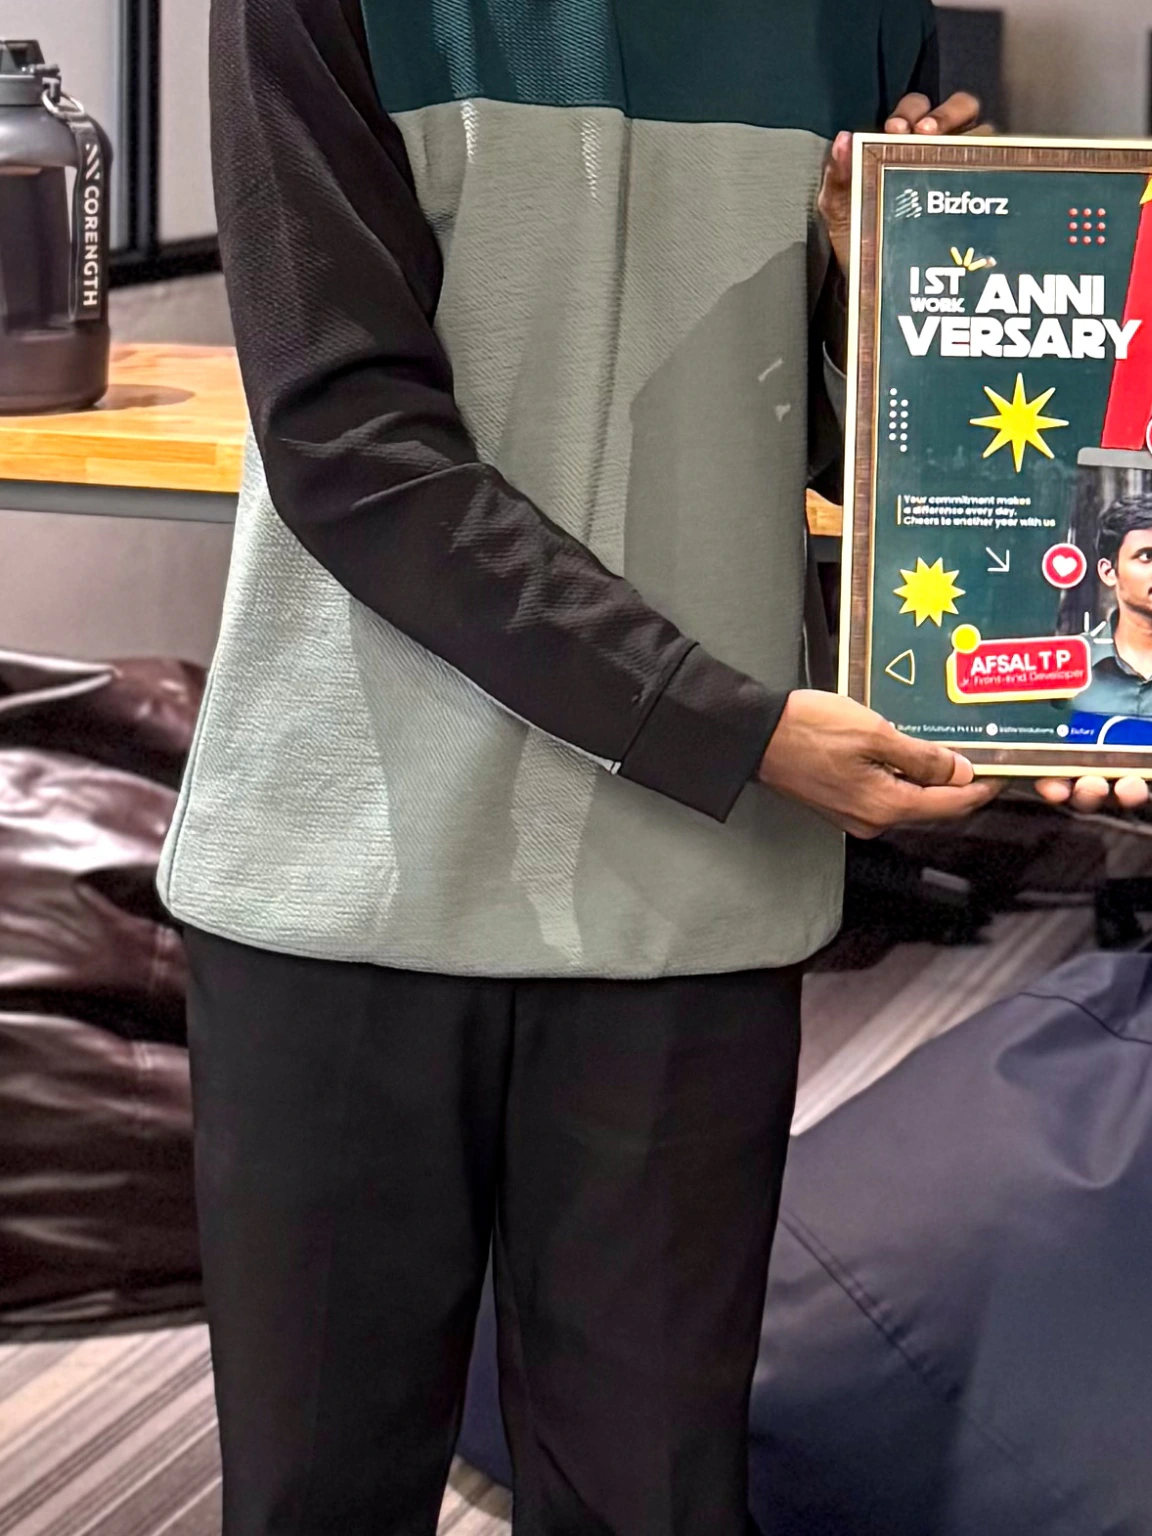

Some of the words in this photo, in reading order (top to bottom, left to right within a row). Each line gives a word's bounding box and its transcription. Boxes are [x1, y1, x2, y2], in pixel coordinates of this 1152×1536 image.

[927, 190, 1009, 215] Bizforz
[83, 185, 100, 307] CORENGTH
[910, 297, 965, 313] WORK
[975, 273, 1105, 316] ANNI
[897, 315, 1143, 359] VERSARY
[903, 494, 927, 505] Your
[928, 495, 995, 506] commitment
[996, 496, 1031, 506] makes
[903, 506, 912, 515] a
[965, 506, 994, 518] every
[903, 515, 940, 526] Cheers
[941, 516, 952, 526] to
[953, 516, 994, 527] another
[995, 518, 1019, 530] year
[1020, 517, 1042, 527] with
[1043, 519, 1056, 528] us
[970, 653, 1037, 676] AFSAL
[1038, 651, 1052, 670] T
[1055, 650, 1071, 669] P
